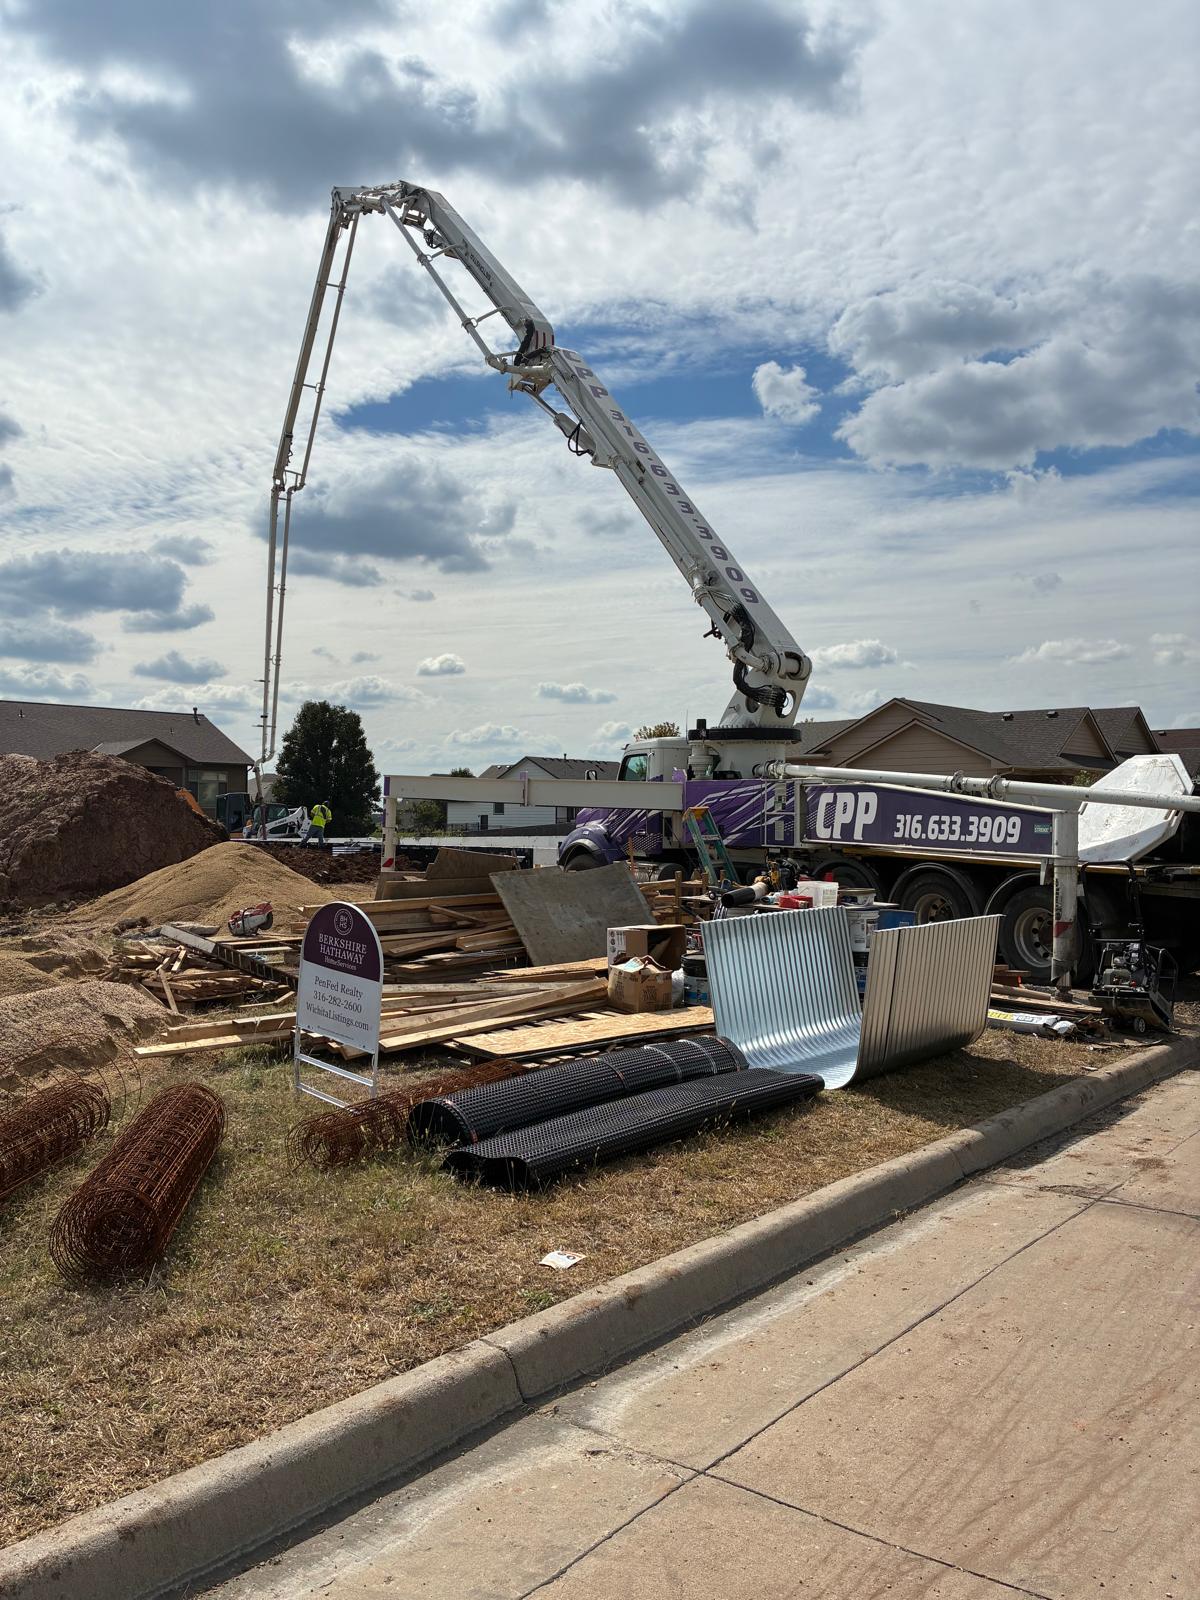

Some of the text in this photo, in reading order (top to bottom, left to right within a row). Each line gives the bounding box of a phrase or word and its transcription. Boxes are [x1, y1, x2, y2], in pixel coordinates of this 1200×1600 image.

[609, 408, 759, 605] 316.633.3909
[816, 791, 878, 840] CPP
[893, 815, 1021, 843] 316.633.3909
[318, 933, 367, 954] BERKSHIRE
[319, 944, 365, 965] HATHAWAY
[314, 975, 363, 1000] PenFed Realty
[313, 990, 362, 1013] 316-282-2600
[306, 1003, 369, 1030] WichitaListings.com
